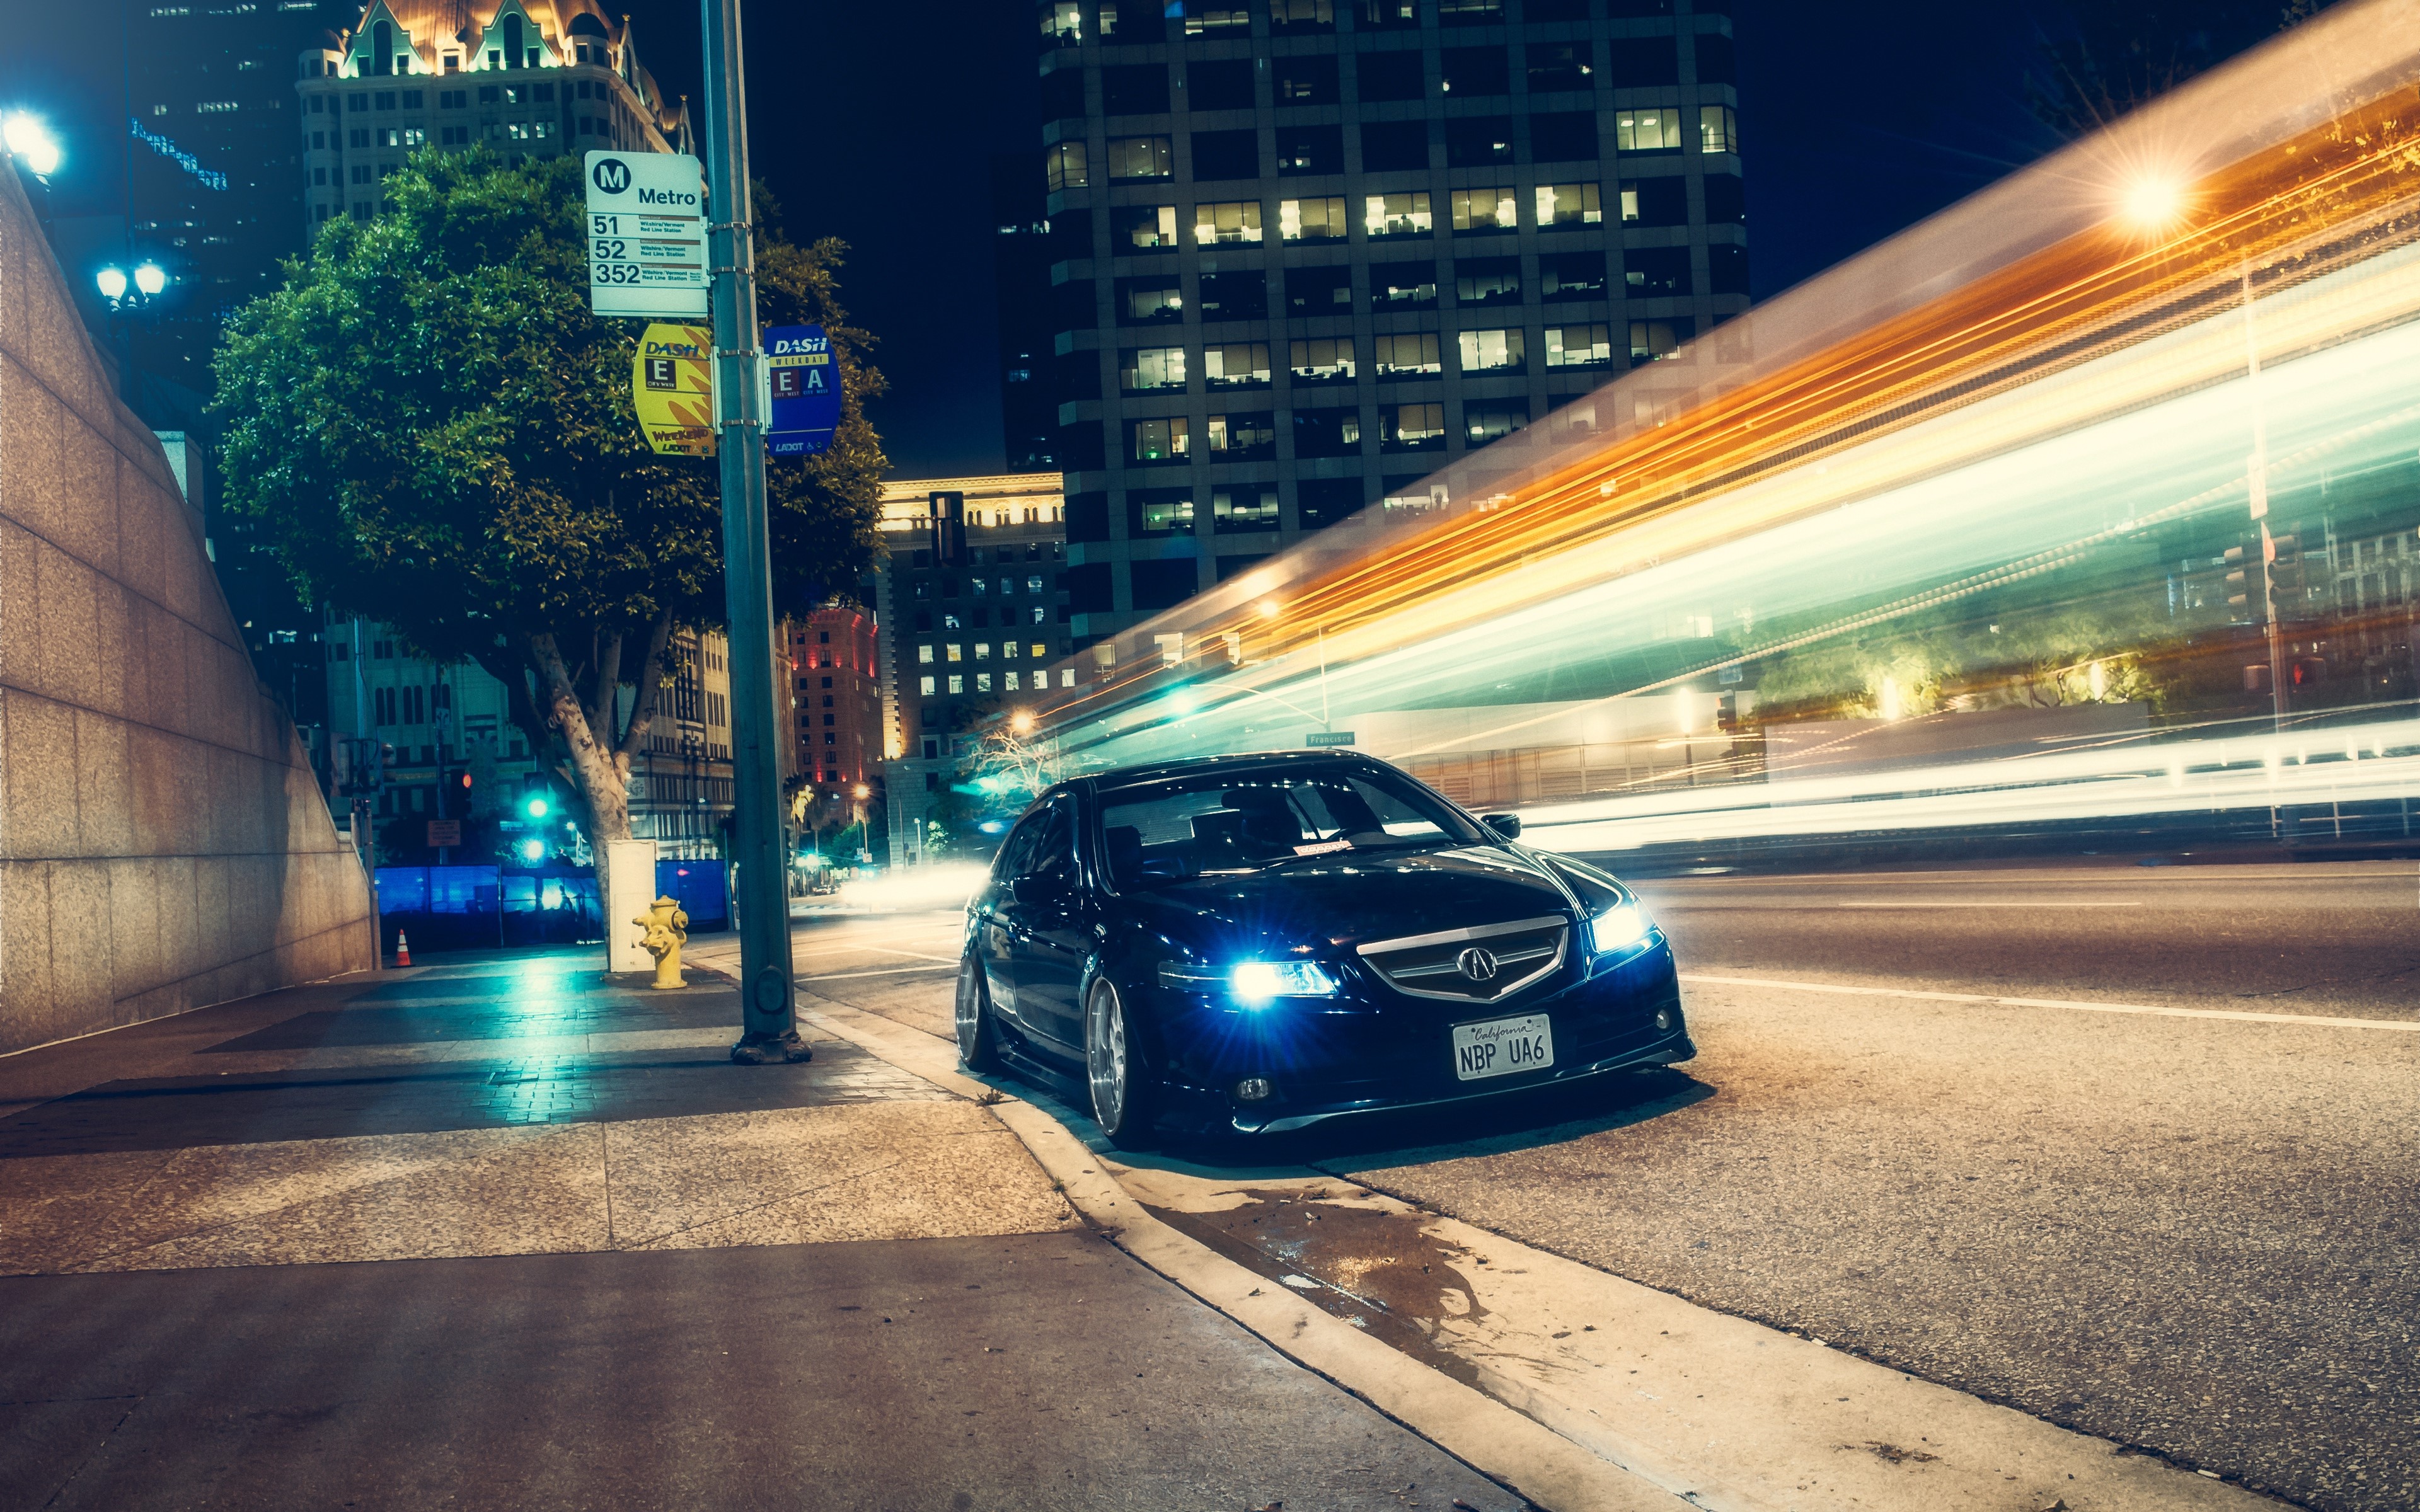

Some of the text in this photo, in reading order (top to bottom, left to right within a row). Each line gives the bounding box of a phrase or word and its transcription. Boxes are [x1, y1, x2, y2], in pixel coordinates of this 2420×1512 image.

[638, 188, 696, 205] Metro
[594, 215, 618, 235] 51
[595, 240, 626, 259] 52
[596, 264, 640, 284] 352
[645, 341, 699, 357] DASH
[775, 338, 827, 353] DASH
[654, 360, 668, 380] E
[776, 356, 822, 365] WEEKDAY
[779, 372, 792, 391] E
[807, 369, 823, 389] A
[776, 443, 804, 452] LADOT
[1475, 1025, 1532, 1041] California
[1460, 1035, 1544, 1072] NBP UA6
